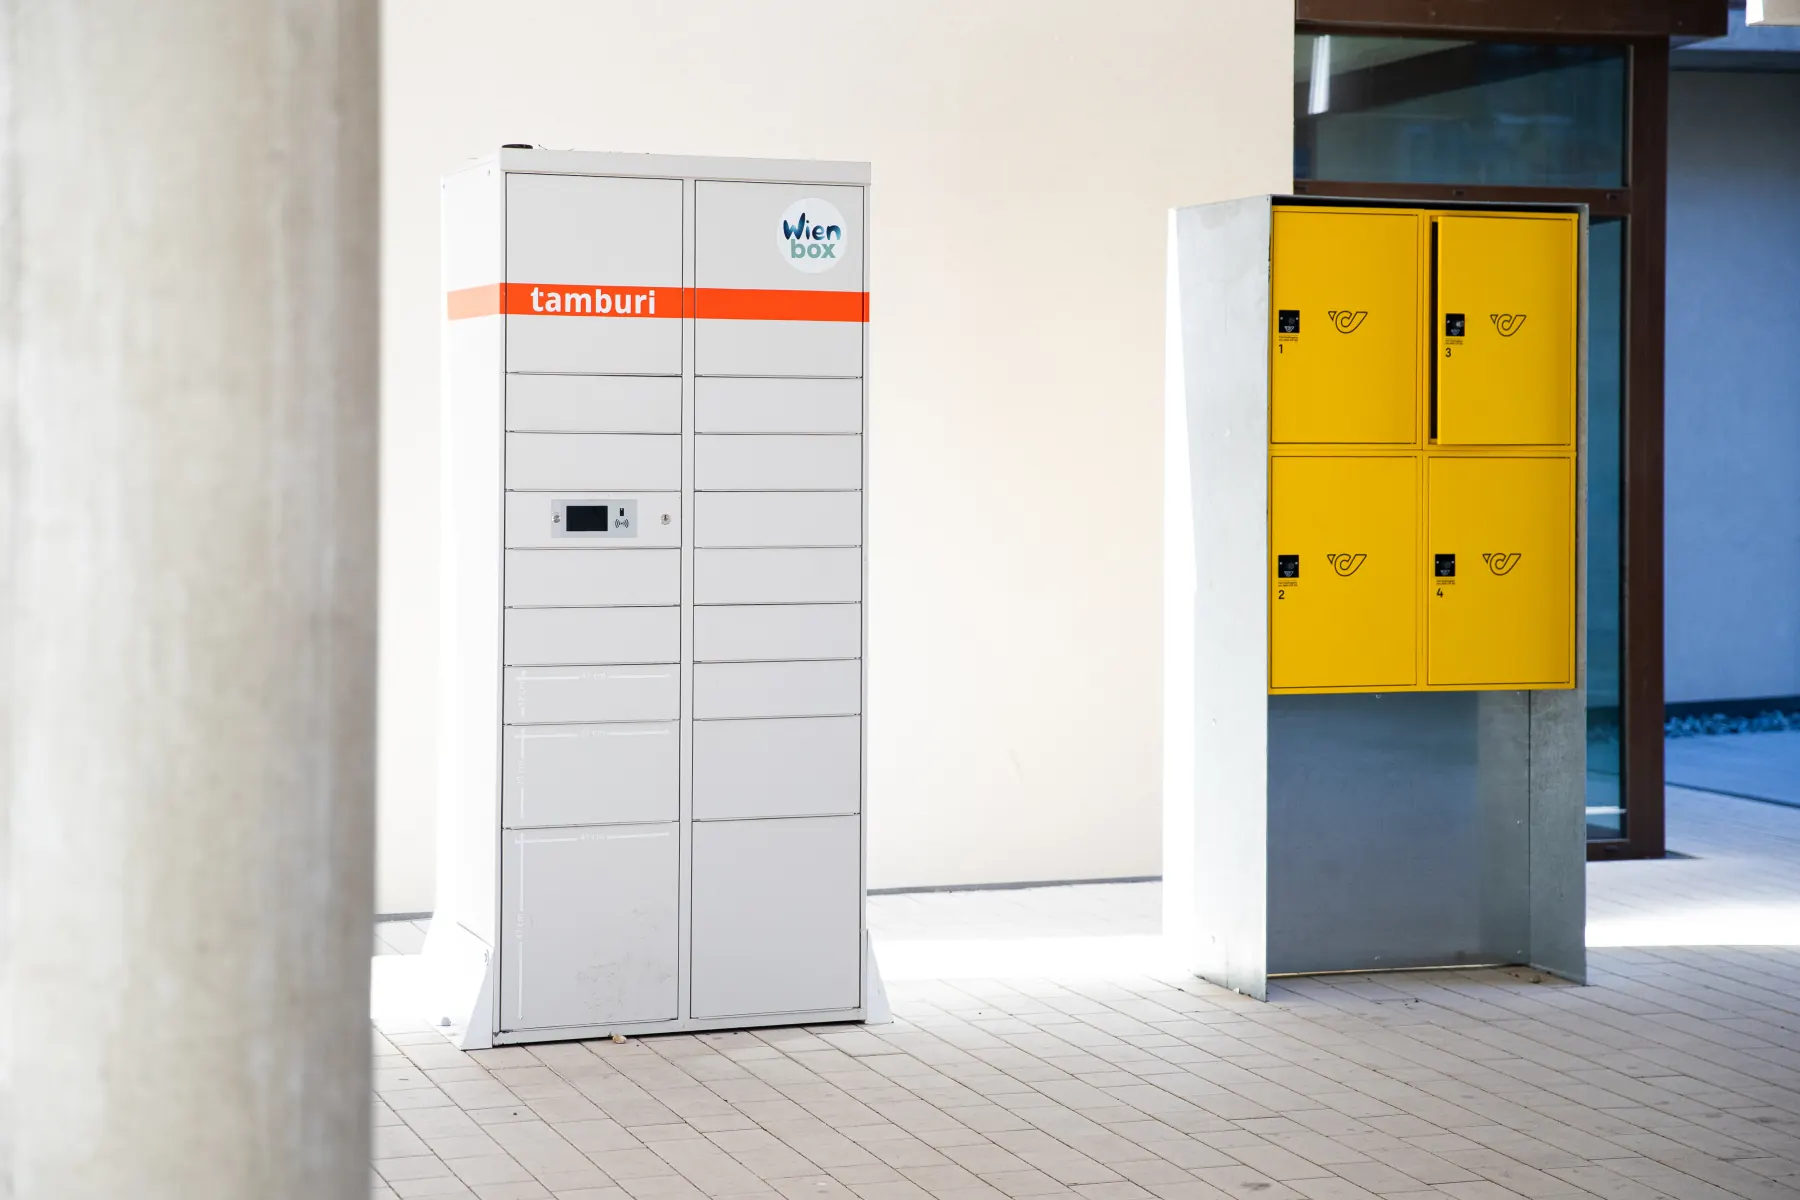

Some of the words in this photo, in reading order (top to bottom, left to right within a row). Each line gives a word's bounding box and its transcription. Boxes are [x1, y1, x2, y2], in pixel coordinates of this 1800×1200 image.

[783, 212, 842, 241] Wien
[790, 239, 836, 259] box
[530, 286, 656, 316] tamburi
[1278, 344, 1283, 354] 1
[1445, 347, 1452, 358] 3
[1278, 589, 1285, 600] 2
[1436, 587, 1444, 598] 4
